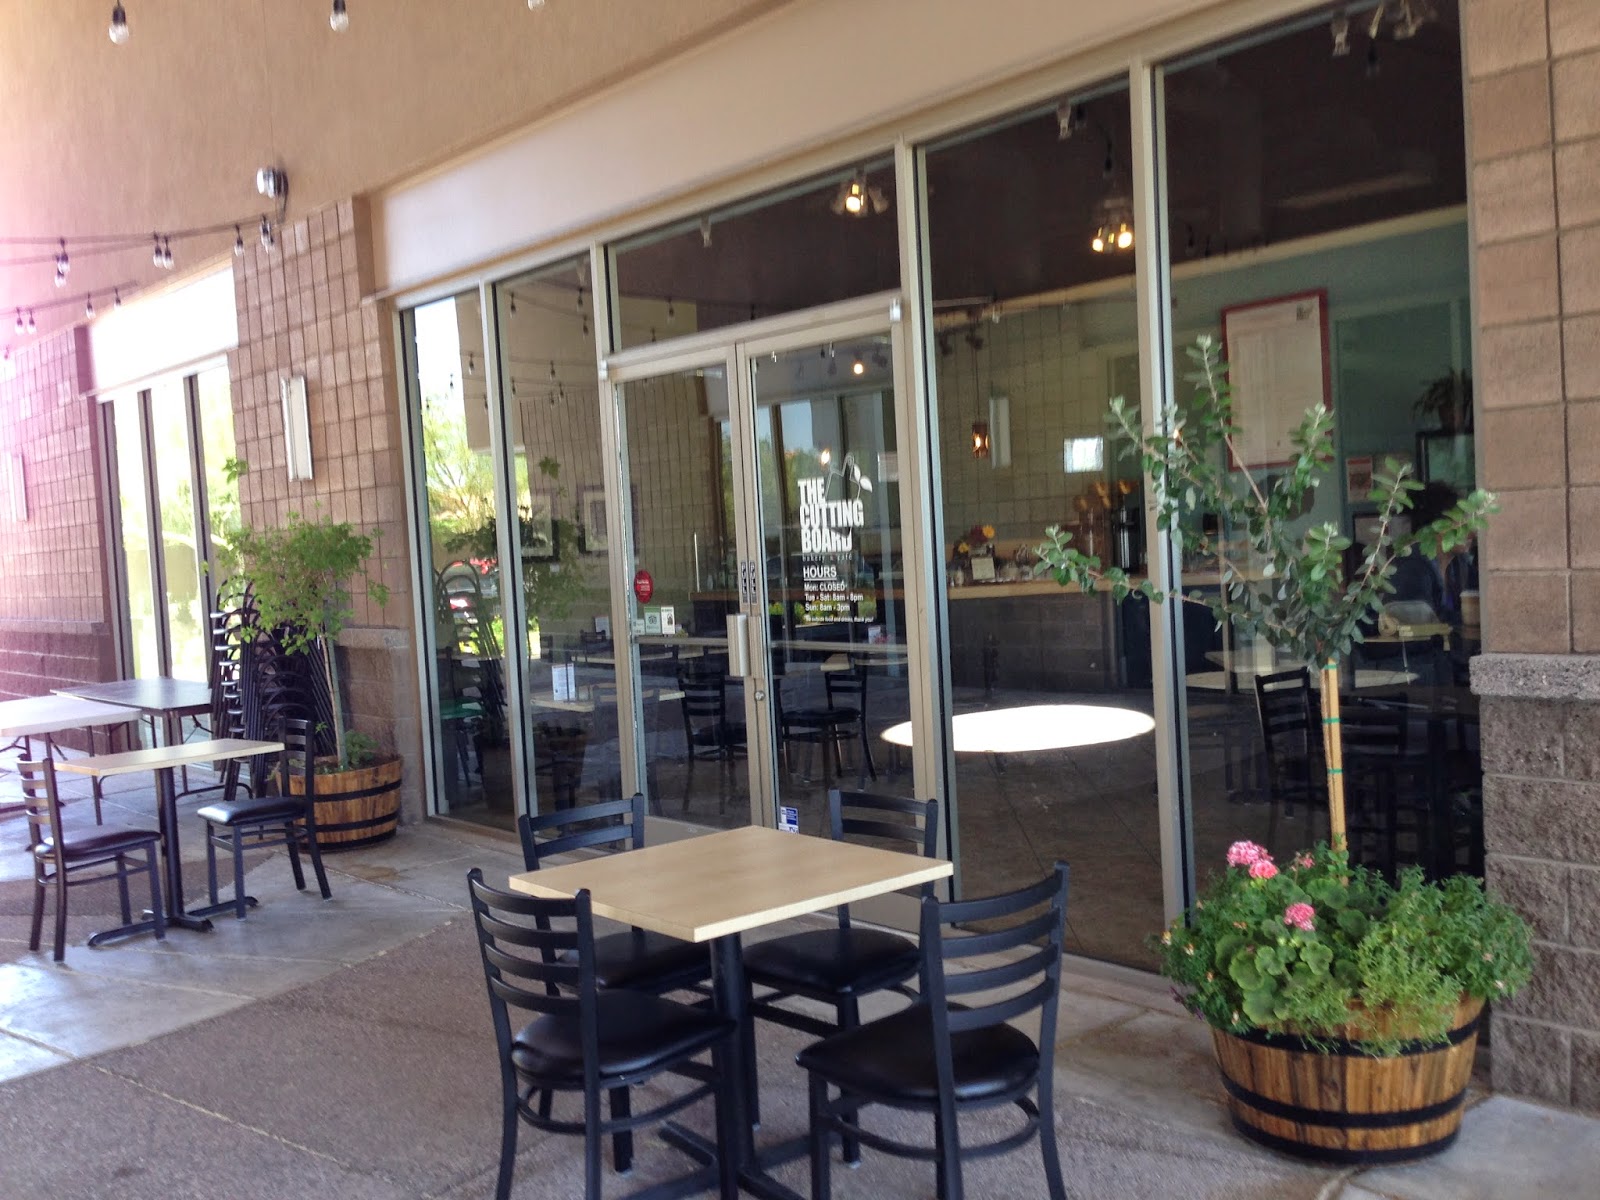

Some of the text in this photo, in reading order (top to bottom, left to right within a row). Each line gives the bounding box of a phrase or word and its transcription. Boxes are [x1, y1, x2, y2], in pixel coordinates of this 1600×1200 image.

[797, 477, 825, 505] THE
[800, 499, 864, 528] CUTTING
[801, 527, 853, 553] BOARD
[803, 565, 837, 579] HOURS
[804, 581, 845, 591] Mon: CLOSED
[805, 593, 815, 601] Tue
[820, 593, 831, 601] Sat:
[805, 603, 818, 611] Sun:
